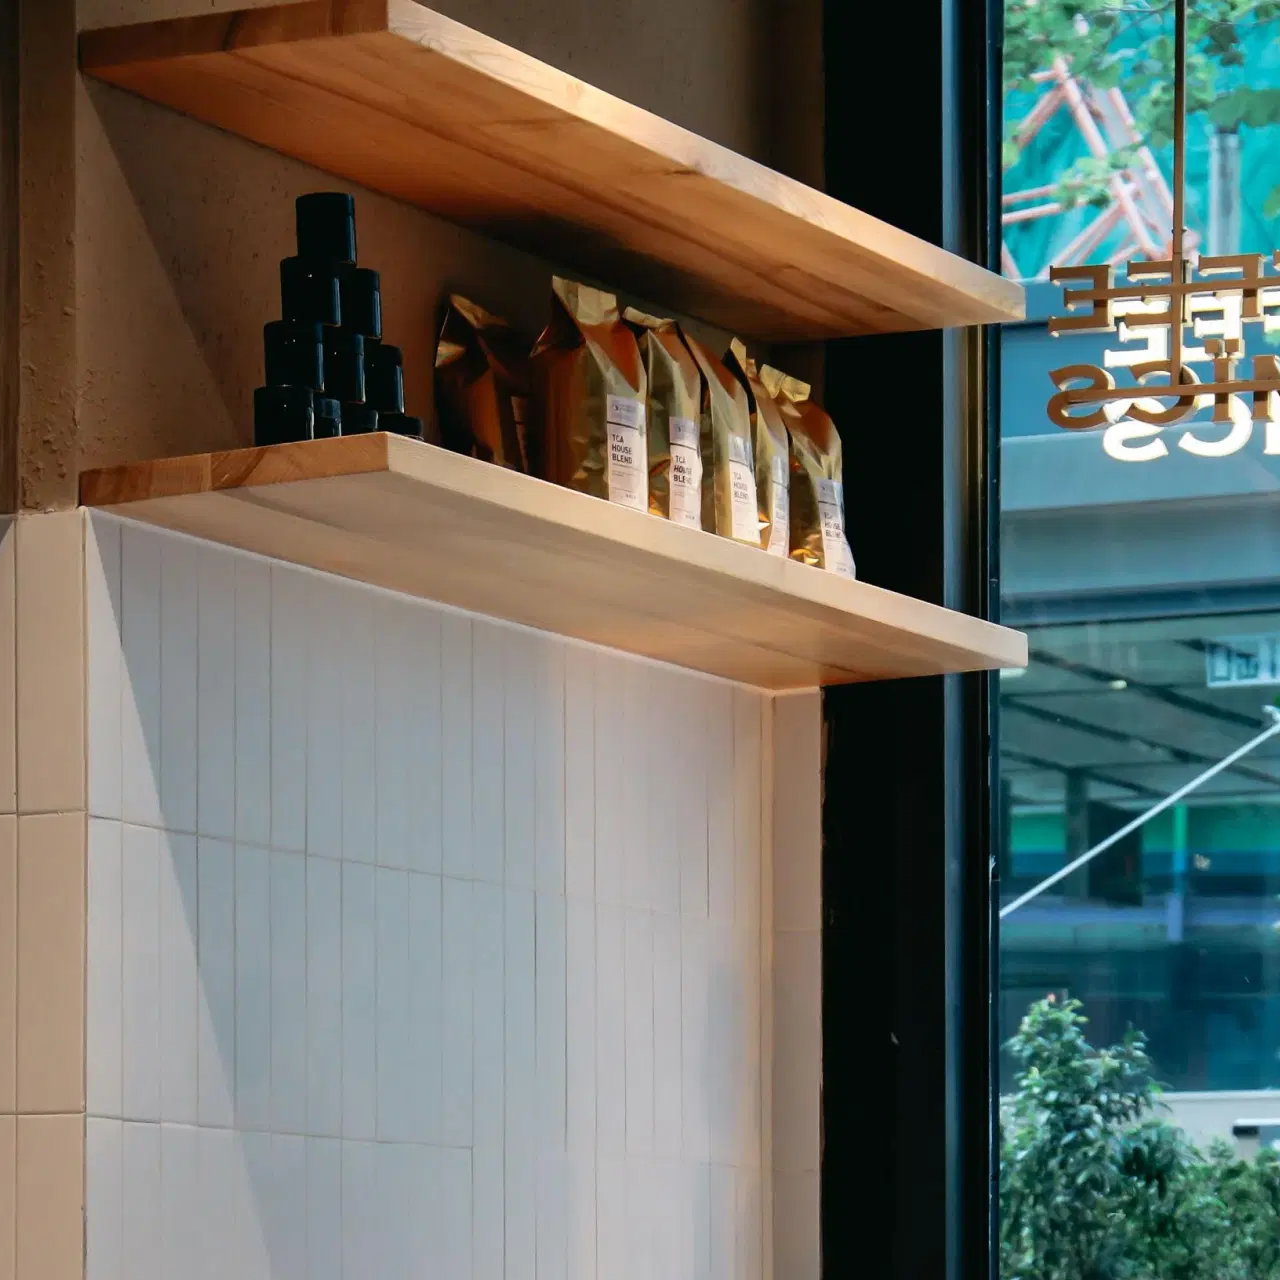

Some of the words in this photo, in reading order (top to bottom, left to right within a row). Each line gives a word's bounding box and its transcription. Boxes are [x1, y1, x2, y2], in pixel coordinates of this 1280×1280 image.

[612, 433, 625, 443] TCA
[612, 444, 632, 456] HOUSE
[612, 454, 633, 465] BLEND
